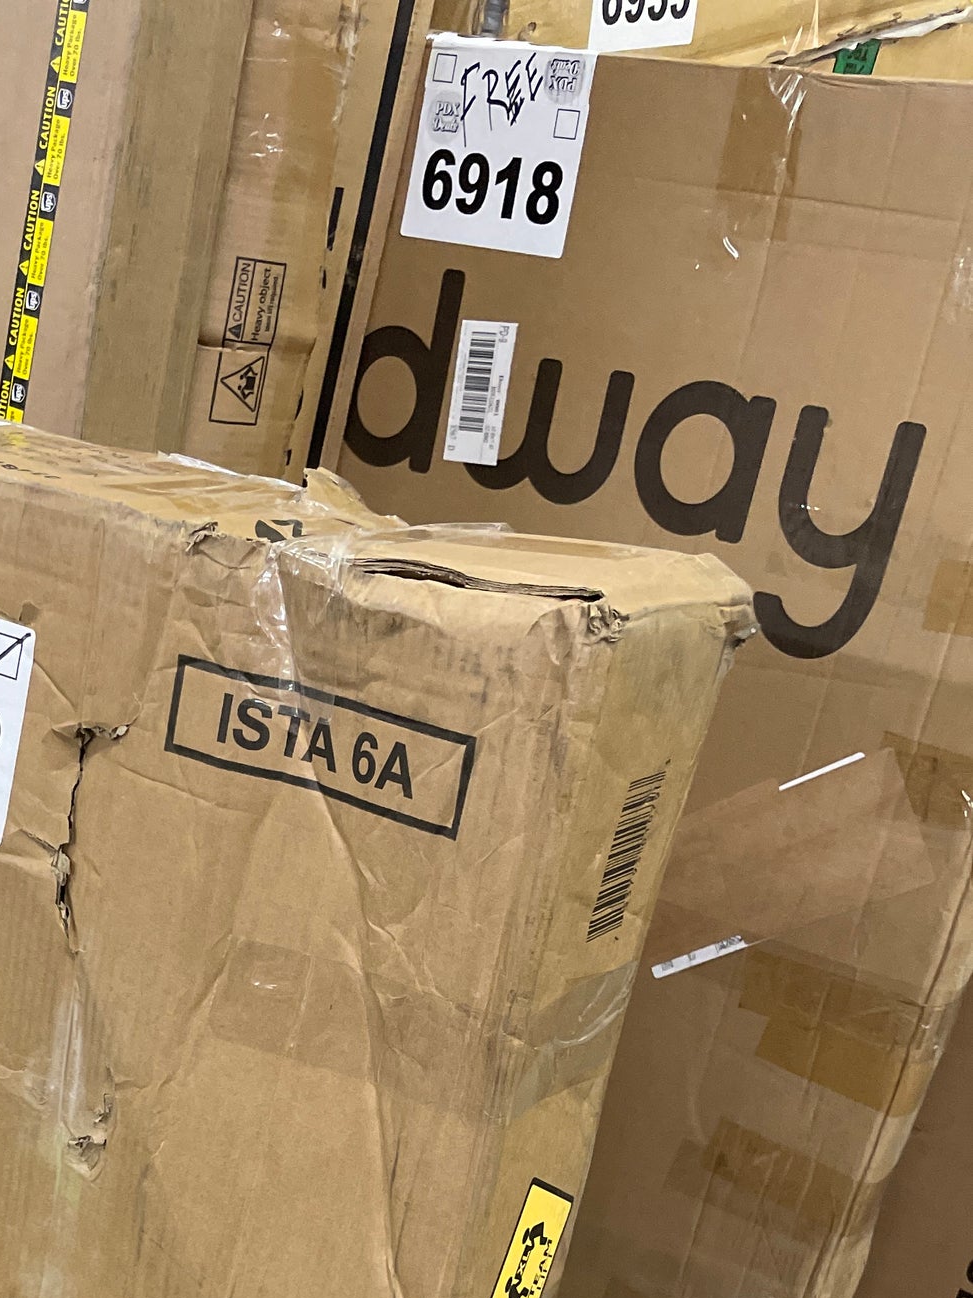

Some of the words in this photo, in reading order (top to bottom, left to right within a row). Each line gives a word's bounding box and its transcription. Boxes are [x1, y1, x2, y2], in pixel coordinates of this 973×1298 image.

[39, 86, 56, 150] CAUTION
[435, 101, 461, 117] PDX
[422, 148, 564, 225] 6918
[23, 189, 40, 251] CAUTION
[8, 287, 24, 346] CAUTION
[233, 263, 252, 322] CAUTION
[251, 306, 266, 341] Heavy
[217, 693, 337, 774] ISTA
[352, 731, 414, 800] 6A
[517, 1255, 528, 1275] XL
